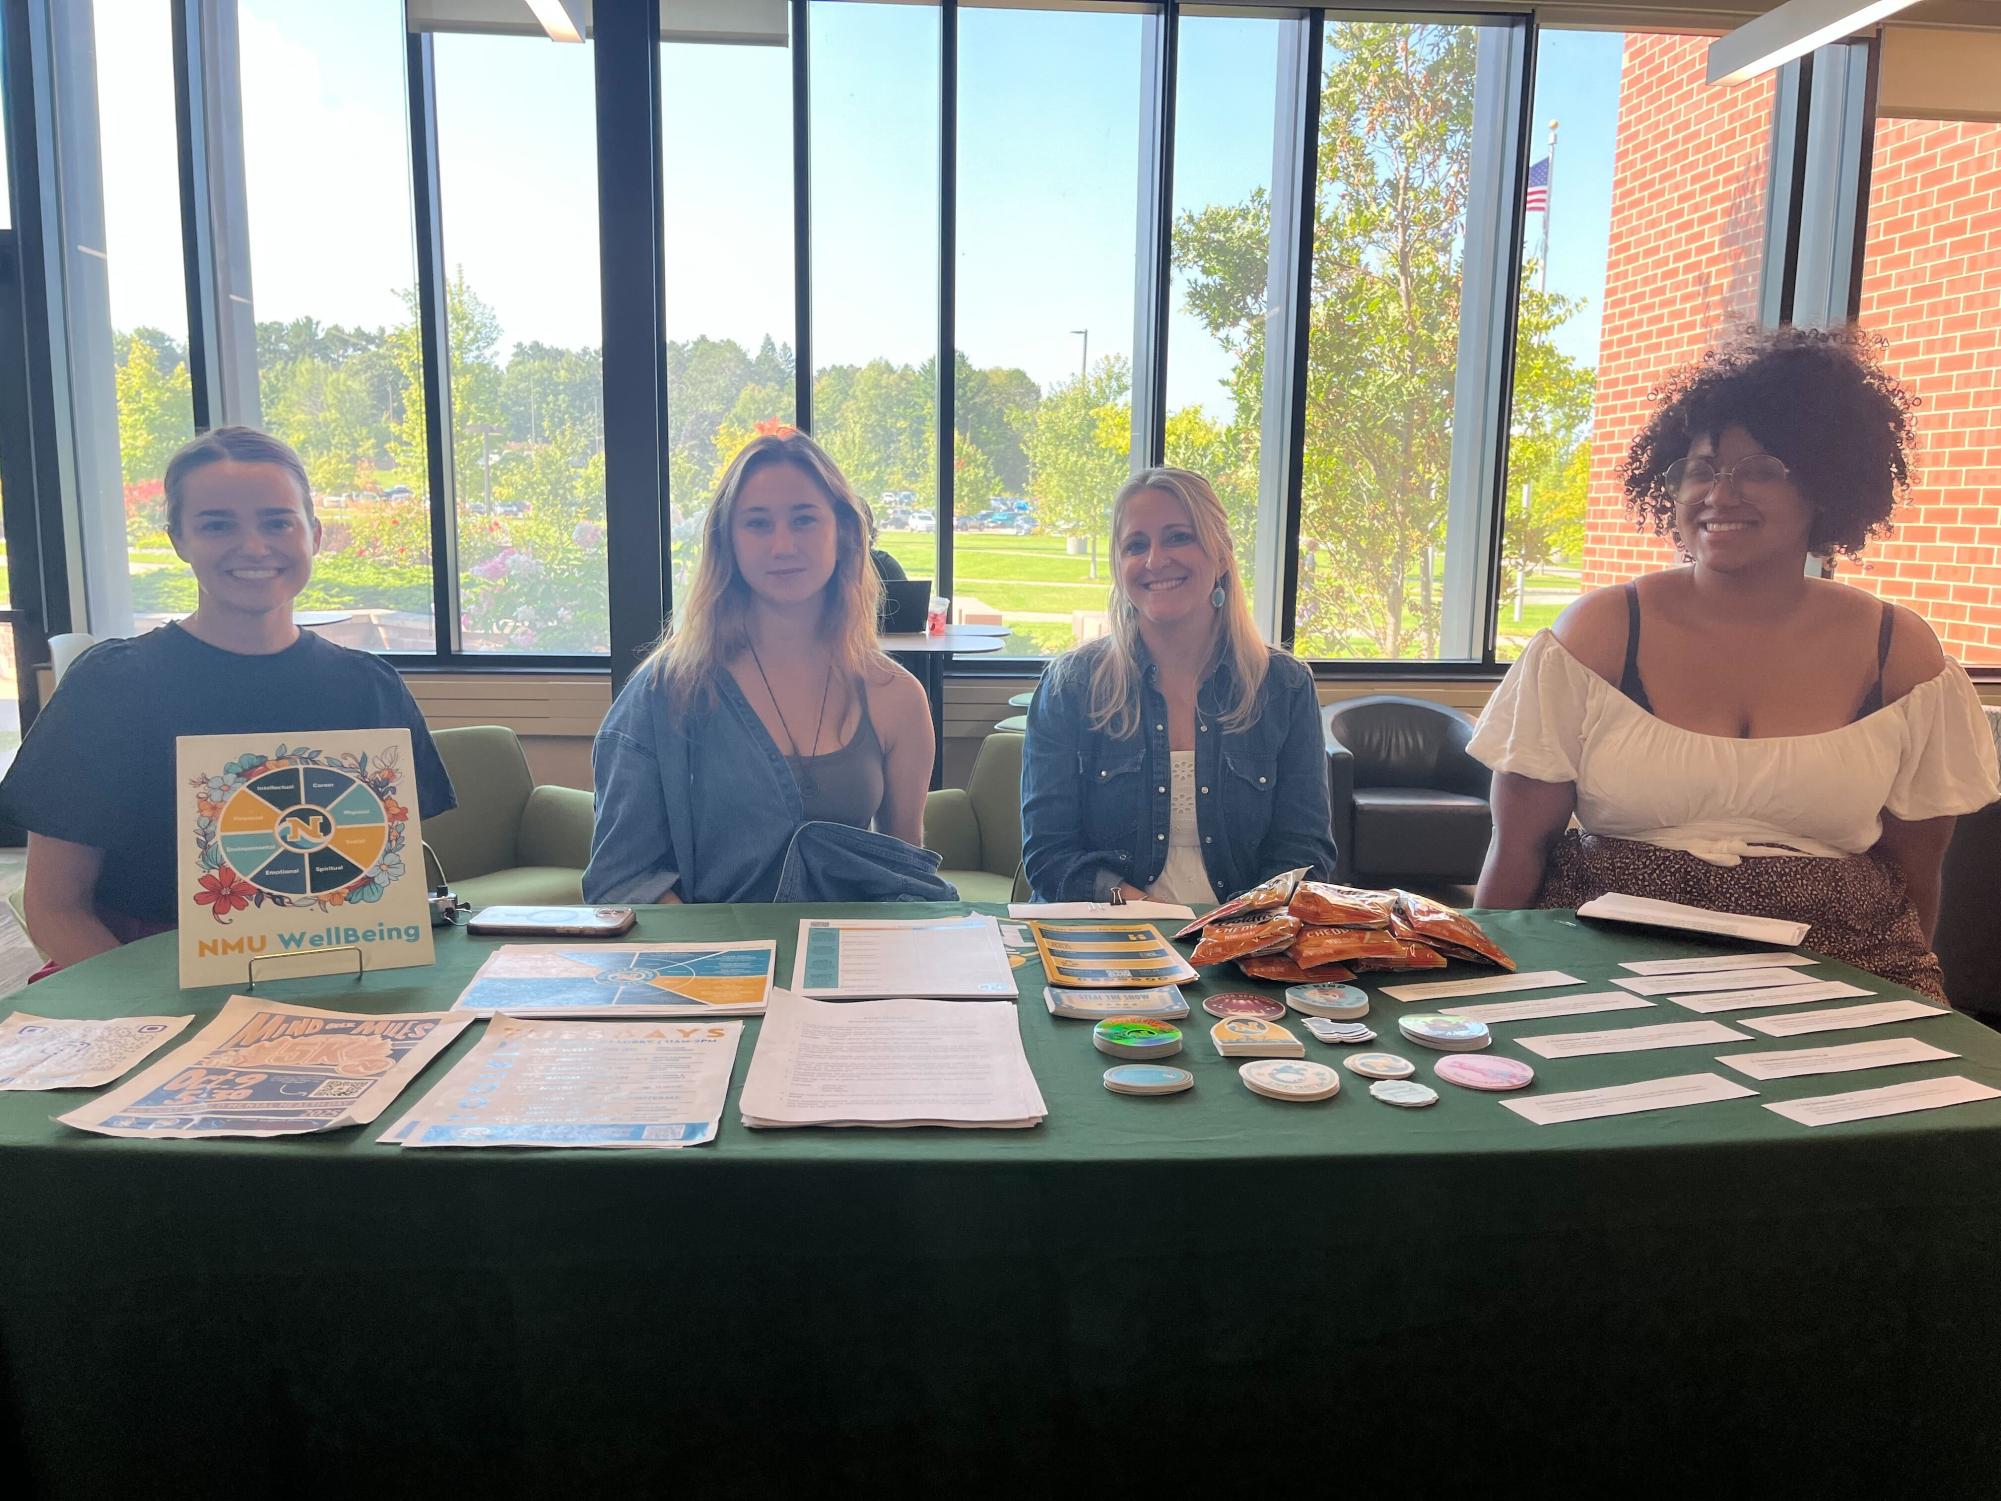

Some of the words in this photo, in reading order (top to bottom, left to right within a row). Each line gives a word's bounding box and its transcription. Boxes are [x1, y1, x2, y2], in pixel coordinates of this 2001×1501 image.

[315, 865, 344, 873] Spiritual
[198, 934, 267, 957] NMU
[278, 922, 420, 950] WellBeing
[303, 1109, 341, 1117] 2025
